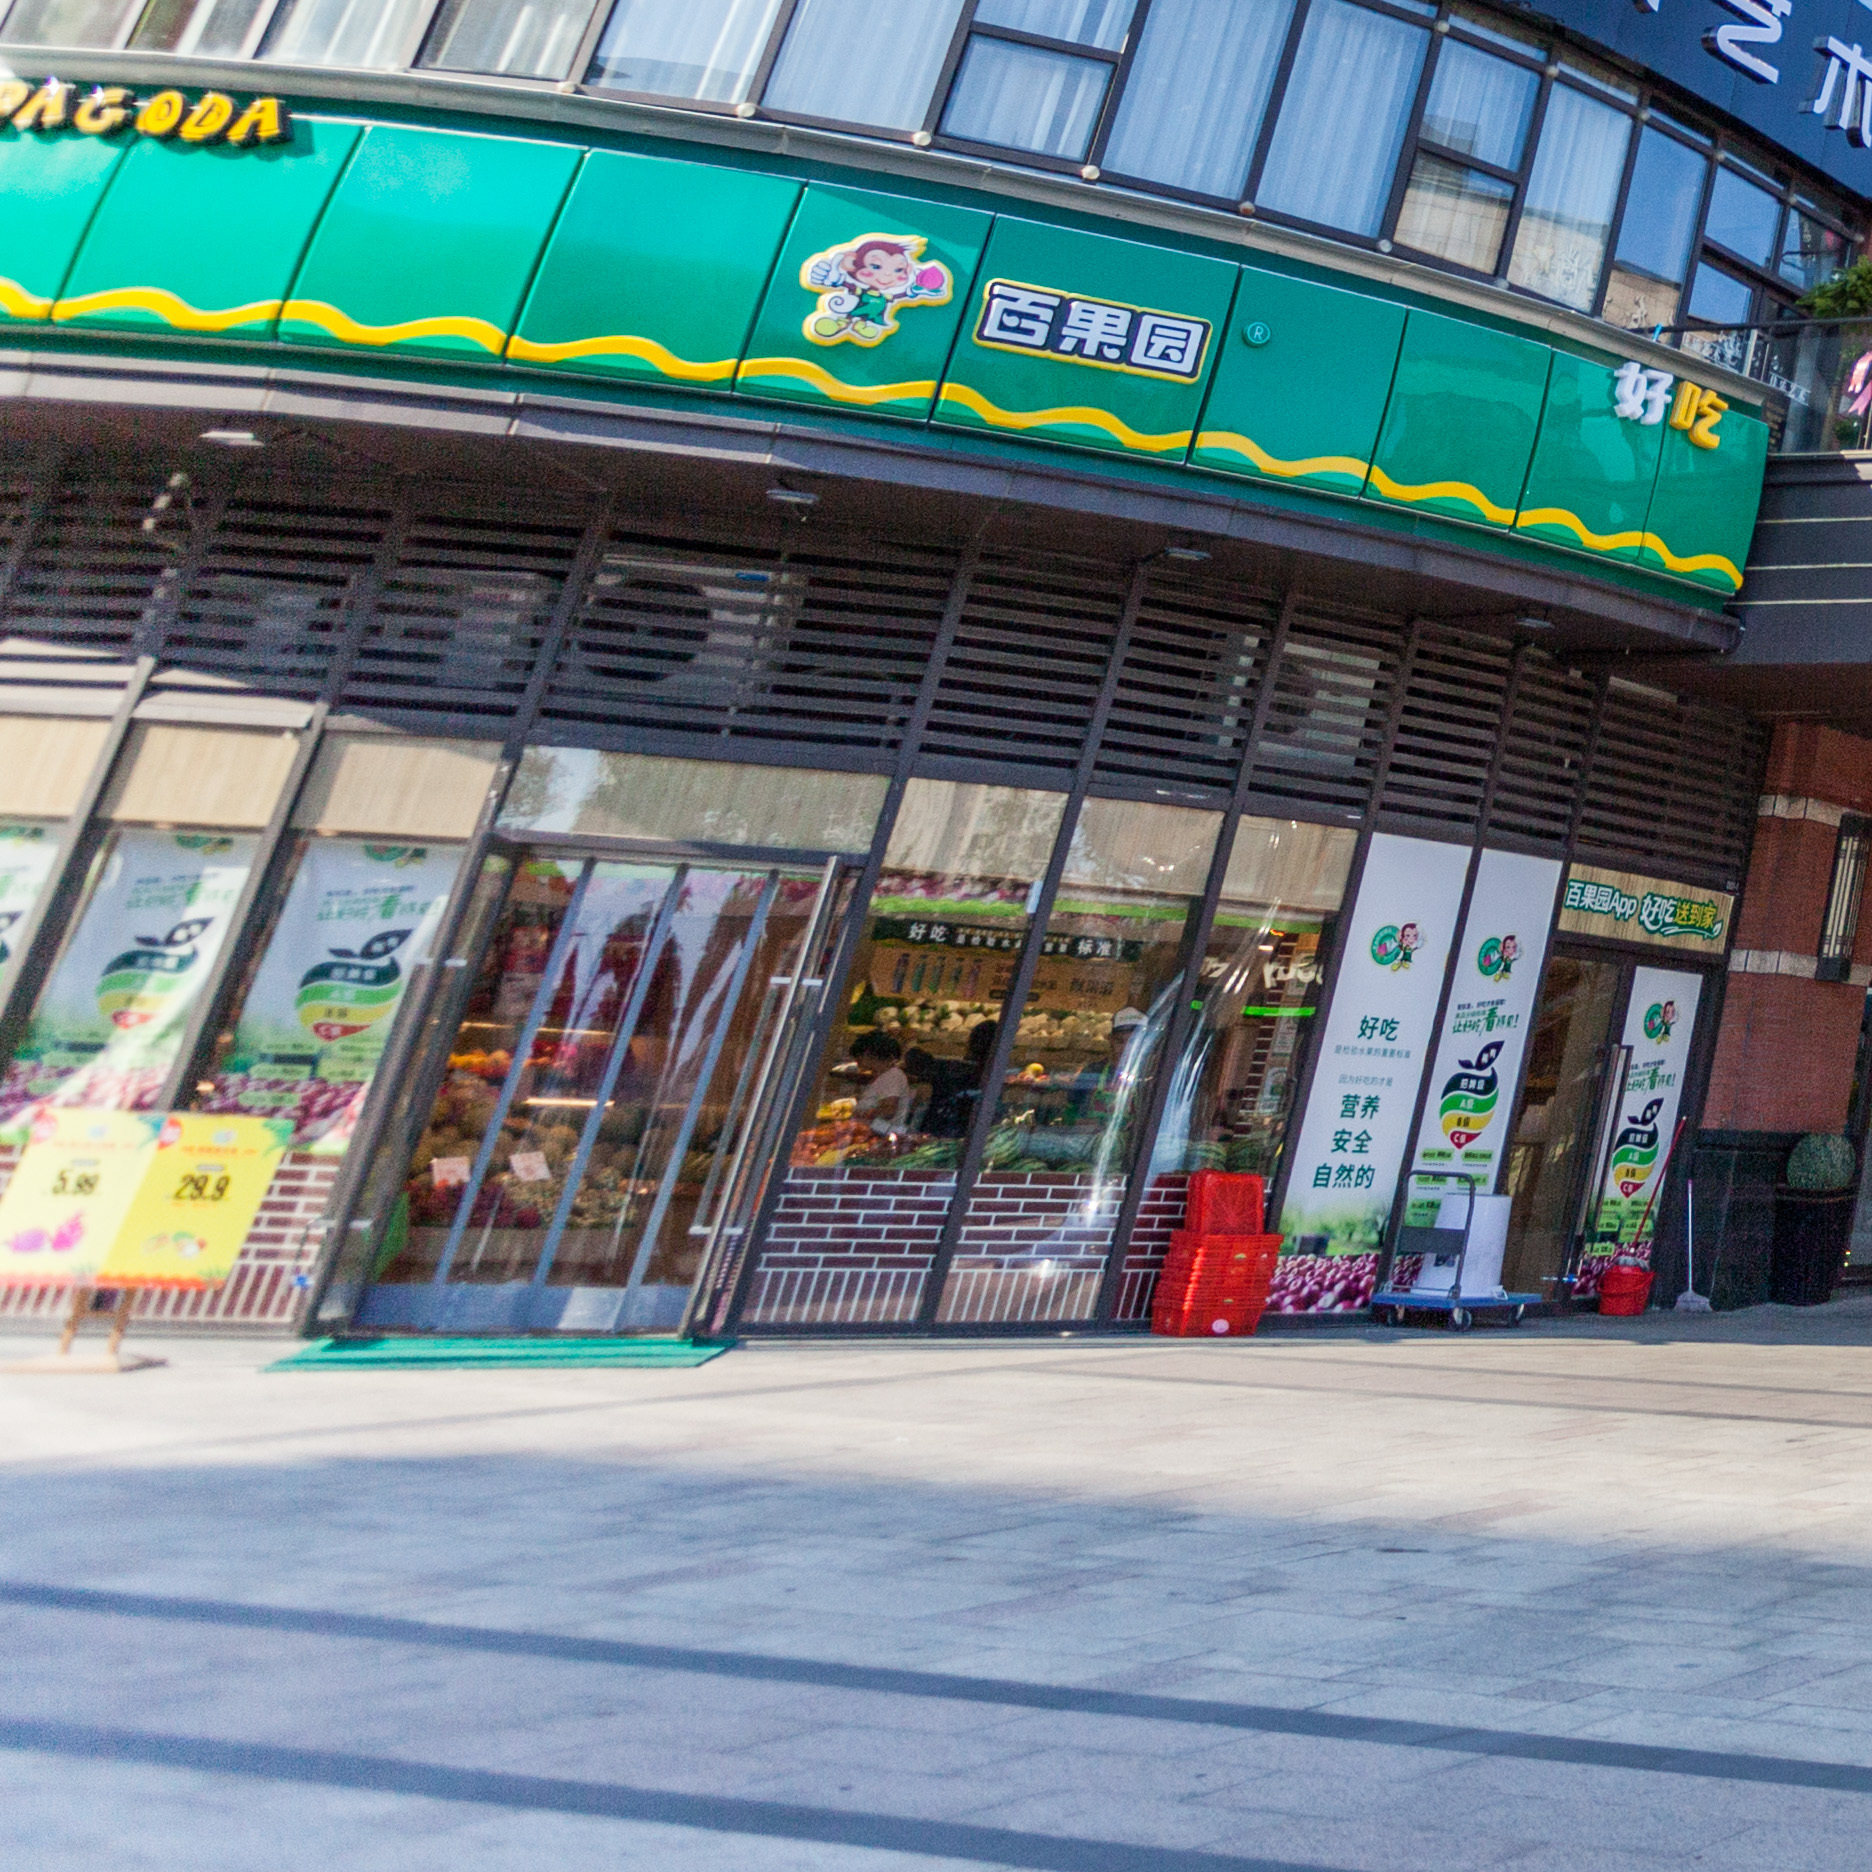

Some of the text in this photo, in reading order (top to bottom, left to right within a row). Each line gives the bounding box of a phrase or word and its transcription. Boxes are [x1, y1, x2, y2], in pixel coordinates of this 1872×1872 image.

[982, 282, 1206, 375] 百果园
[1613, 361, 1729, 450] 好吃
[1565, 880, 1718, 930] 百果园App 好吃送到家
[908, 921, 950, 944] 好吃
[1357, 1015, 1400, 1042] 好吃
[1339, 1093, 1381, 1120] 营养
[1331, 1128, 1373, 1154] 安全
[1312, 1162, 1376, 1189] 自然的
